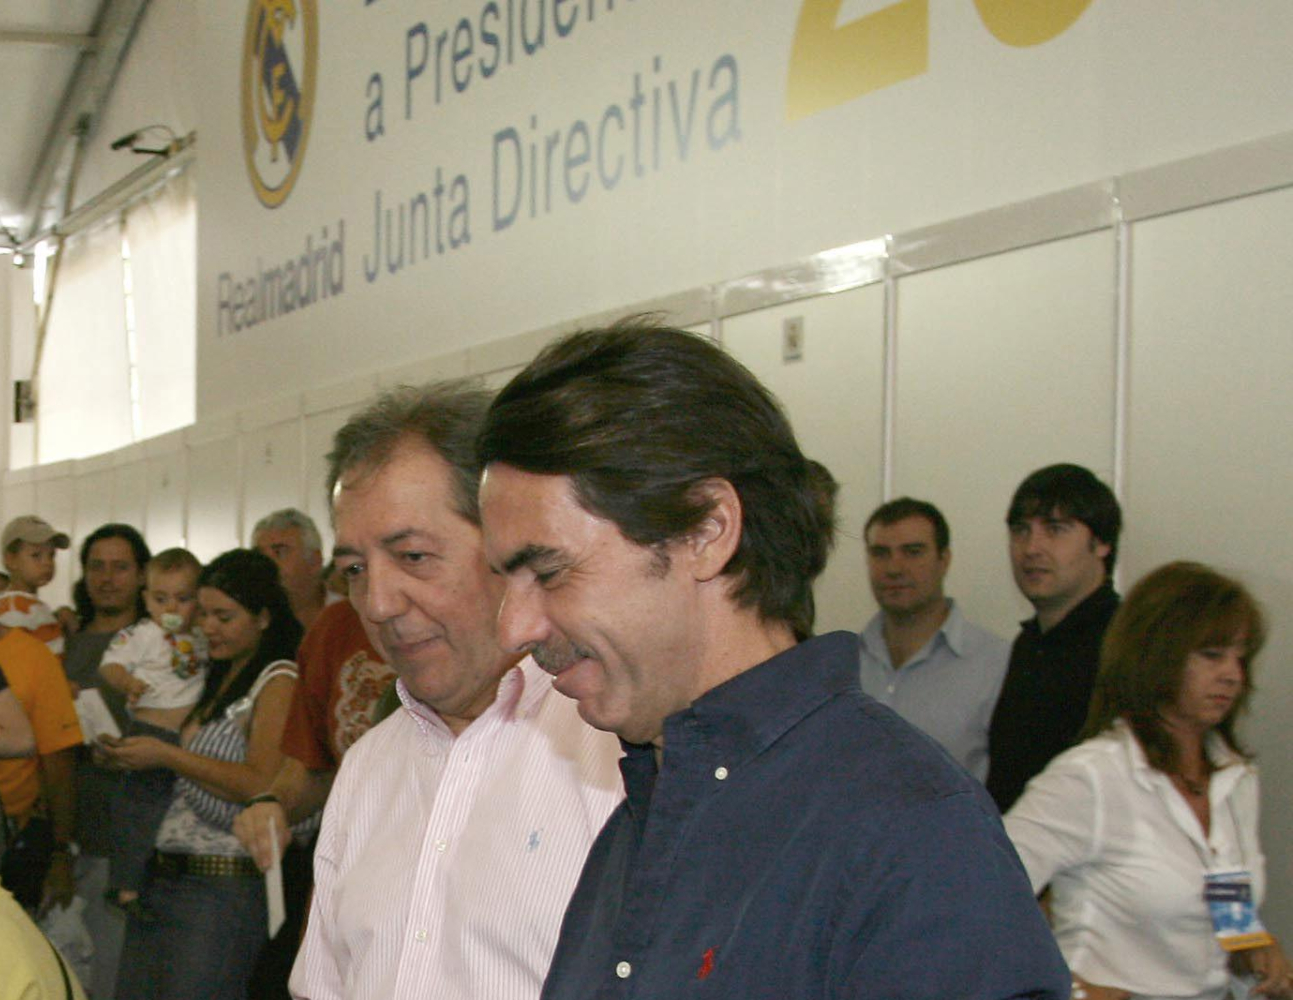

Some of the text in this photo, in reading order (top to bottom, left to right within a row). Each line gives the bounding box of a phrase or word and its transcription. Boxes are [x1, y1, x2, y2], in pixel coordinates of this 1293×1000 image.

[364, 72, 386, 142] a
[363, 167, 472, 283] Junta
[491, 54, 743, 232] Directiva
[217, 218, 345, 337] Realmadrid
